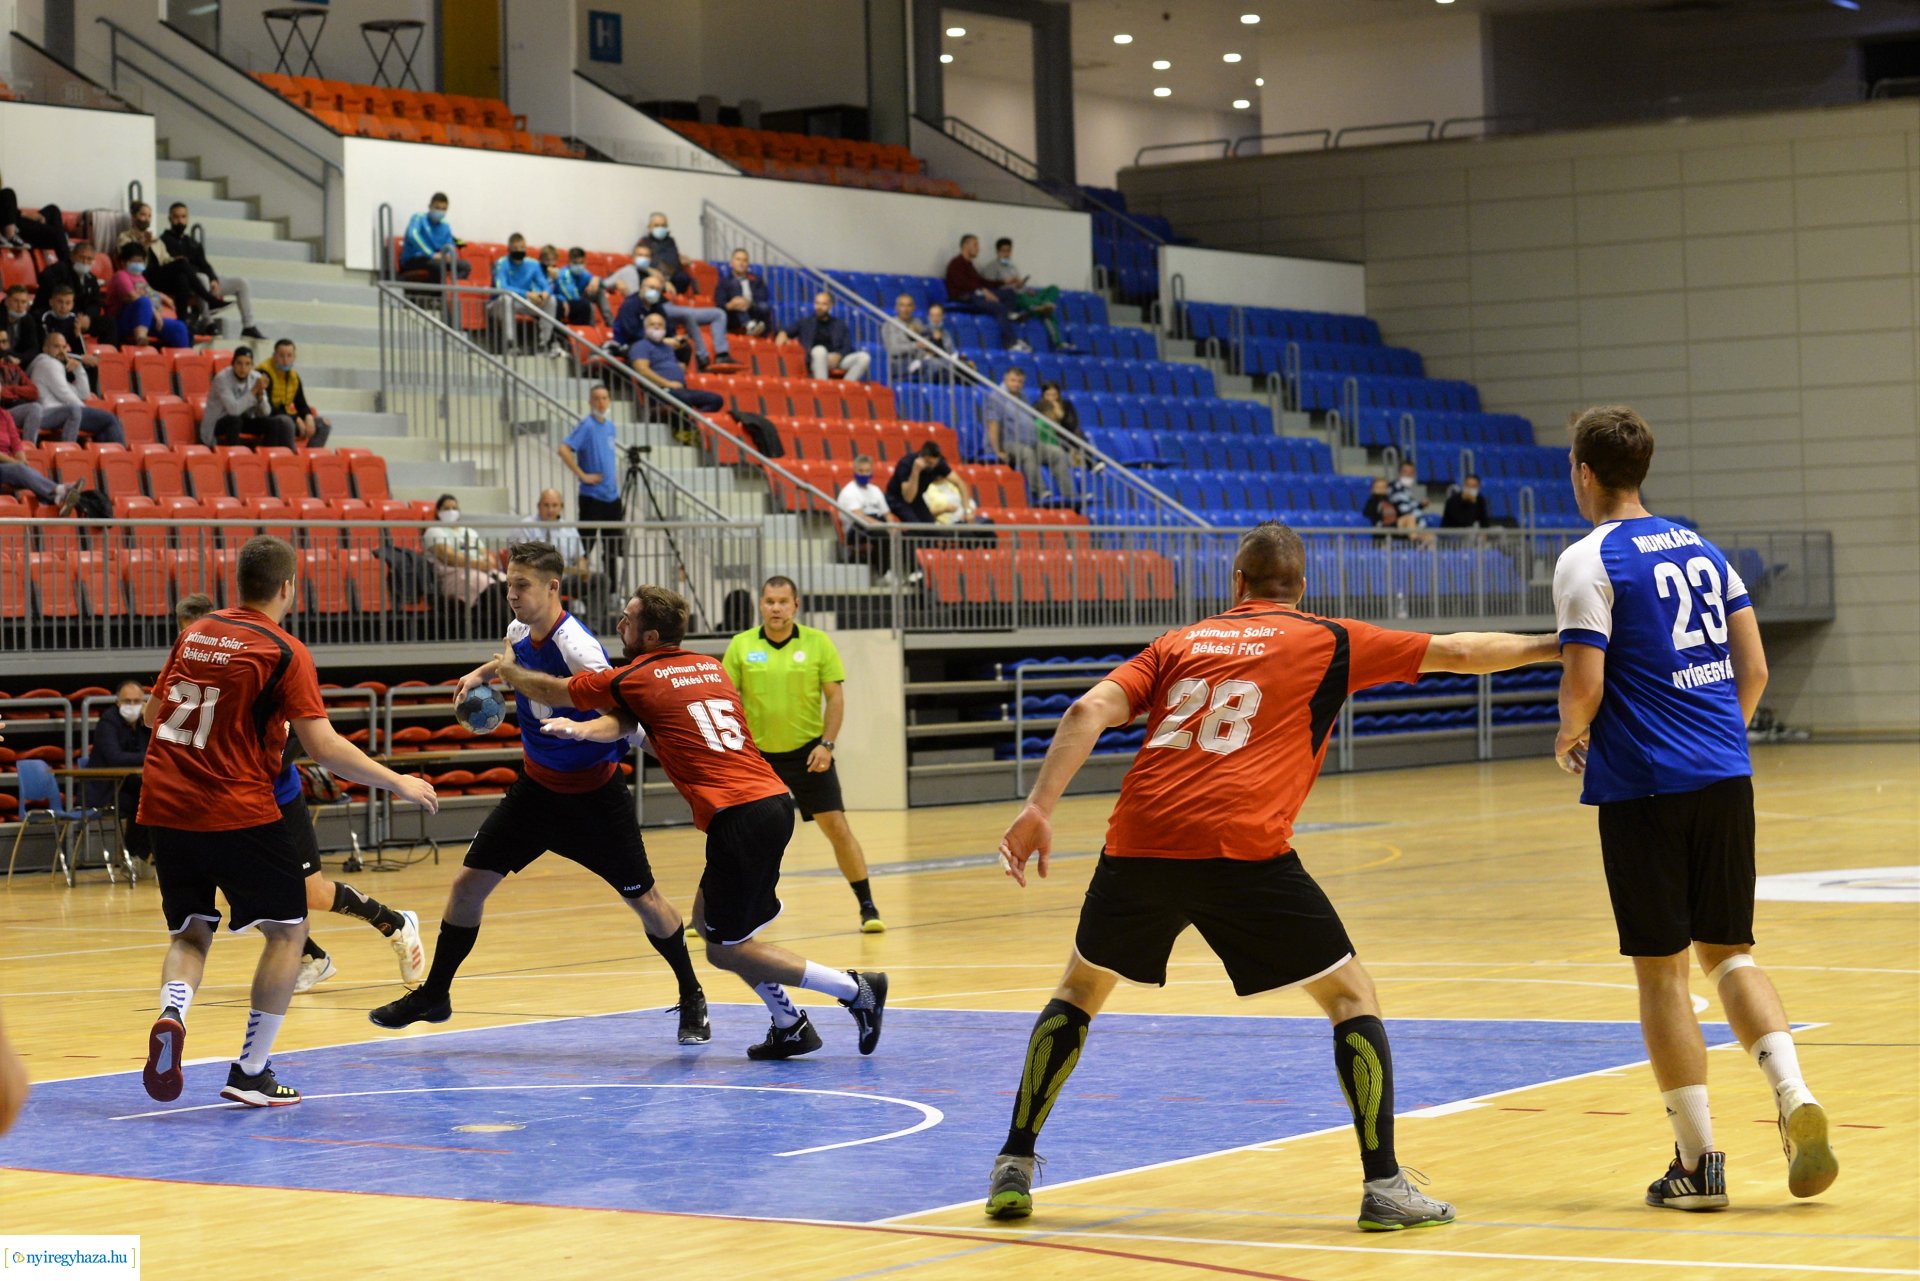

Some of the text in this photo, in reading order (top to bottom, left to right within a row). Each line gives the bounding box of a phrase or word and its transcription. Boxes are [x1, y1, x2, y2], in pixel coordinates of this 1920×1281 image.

[1653, 556, 1728, 651] 23
[1242, 626, 1278, 638] Solar
[219, 636, 243, 650] Solar
[1191, 641, 1265, 655] Békési FKC
[183, 647, 212, 661] Békési
[654, 665, 696, 678] Optimum
[696, 662, 718, 671] Solar
[671, 673, 721, 688] Békési FKC
[156, 680, 221, 750] 21
[1146, 677, 1263, 756] 28
[686, 699, 746, 753] 15
